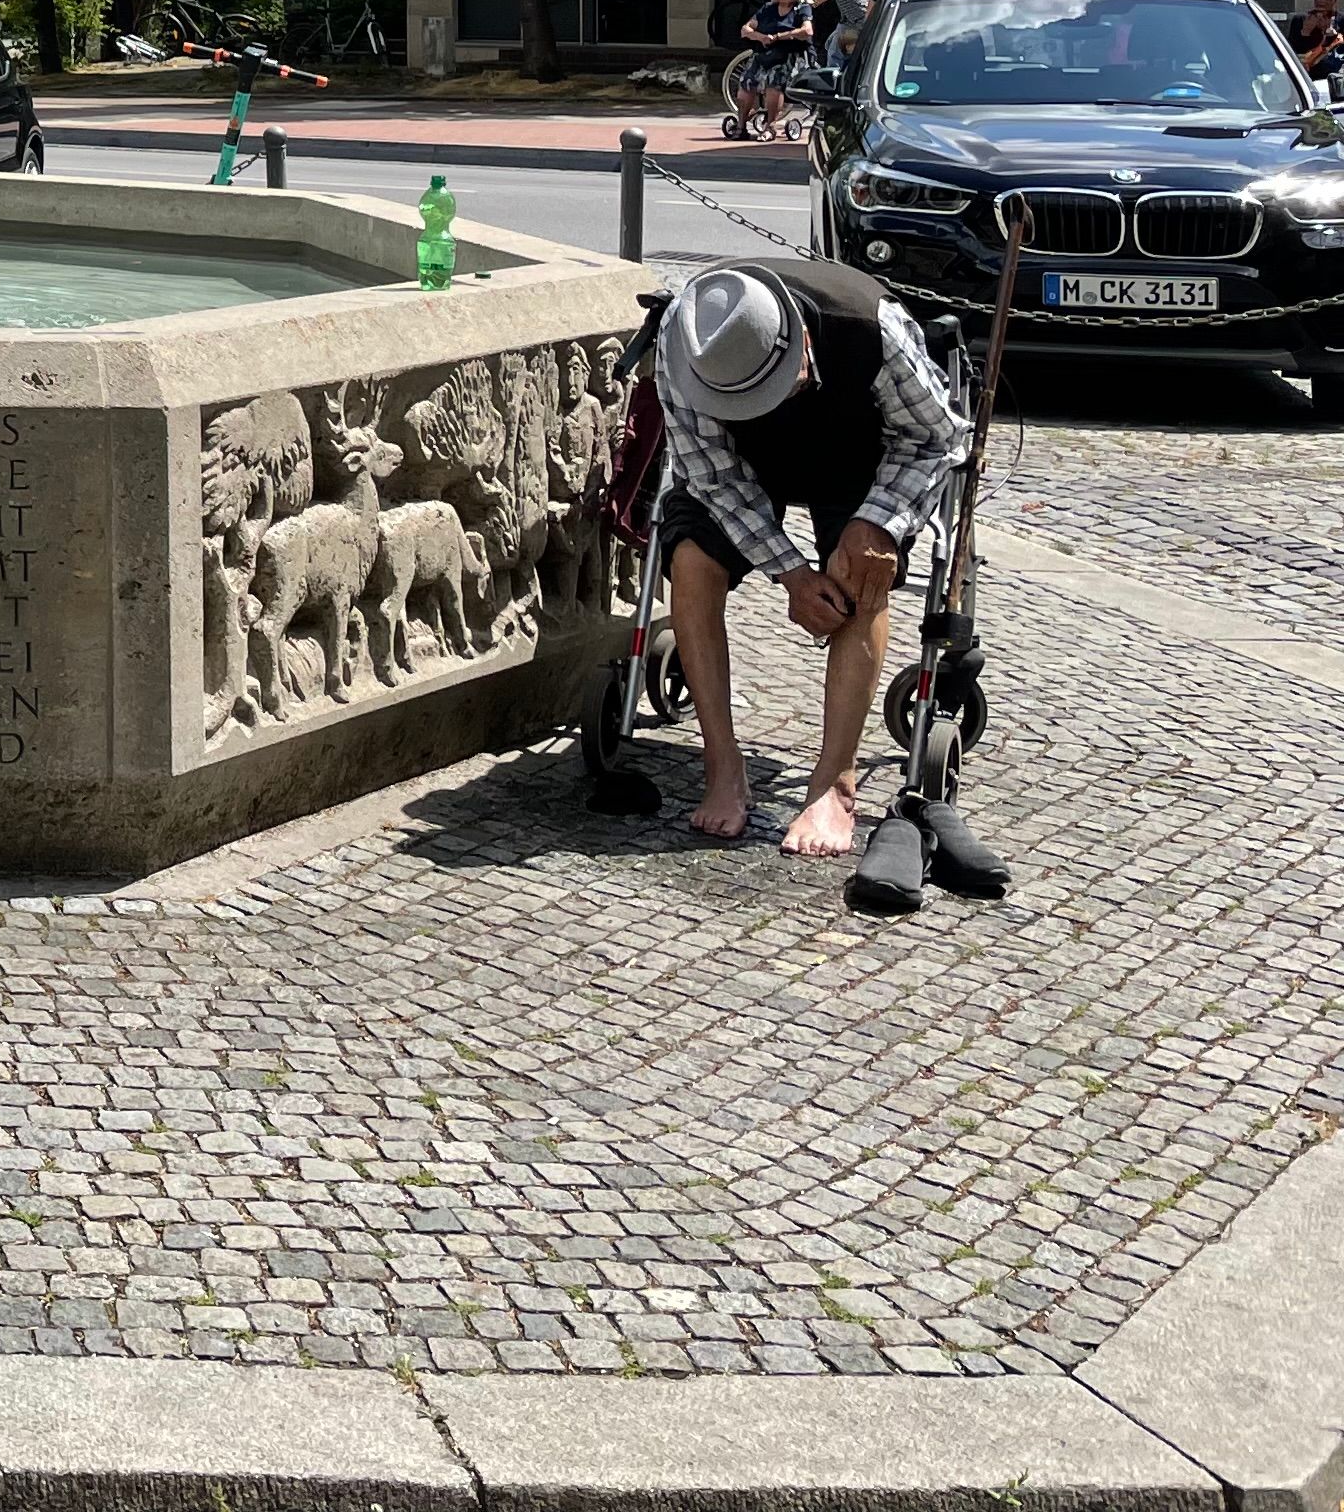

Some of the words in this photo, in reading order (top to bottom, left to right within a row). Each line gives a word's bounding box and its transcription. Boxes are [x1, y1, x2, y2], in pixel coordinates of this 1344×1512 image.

[1063, 279, 1080, 302] M
[1100, 281, 1136, 305] CK
[1144, 282, 1214, 306] 3131
